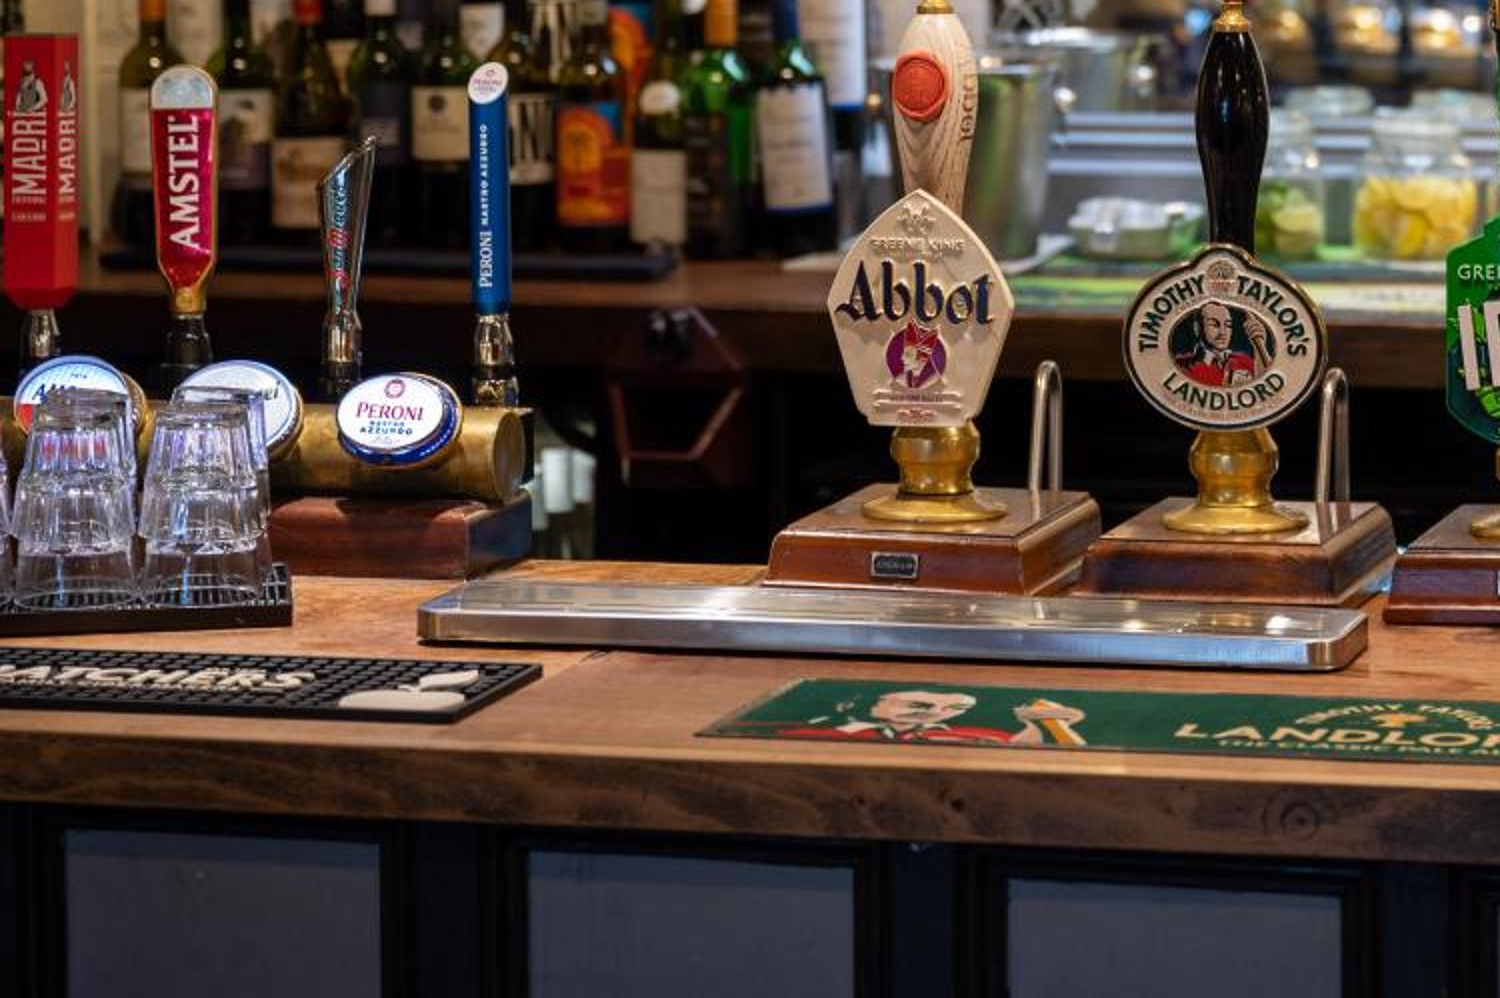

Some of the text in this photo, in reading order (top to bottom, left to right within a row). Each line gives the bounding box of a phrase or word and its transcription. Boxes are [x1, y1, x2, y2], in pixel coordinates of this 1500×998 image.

[167, 114, 202, 252] AMSTEL
[479, 230, 493, 288] PERONI
[834, 257, 994, 325] Abbot
[1139, 273, 1311, 357] TIMOTHY TAYLOR'S
[356, 402, 425, 421] PERONI
[1162, 372, 1285, 411] LANDLORD
